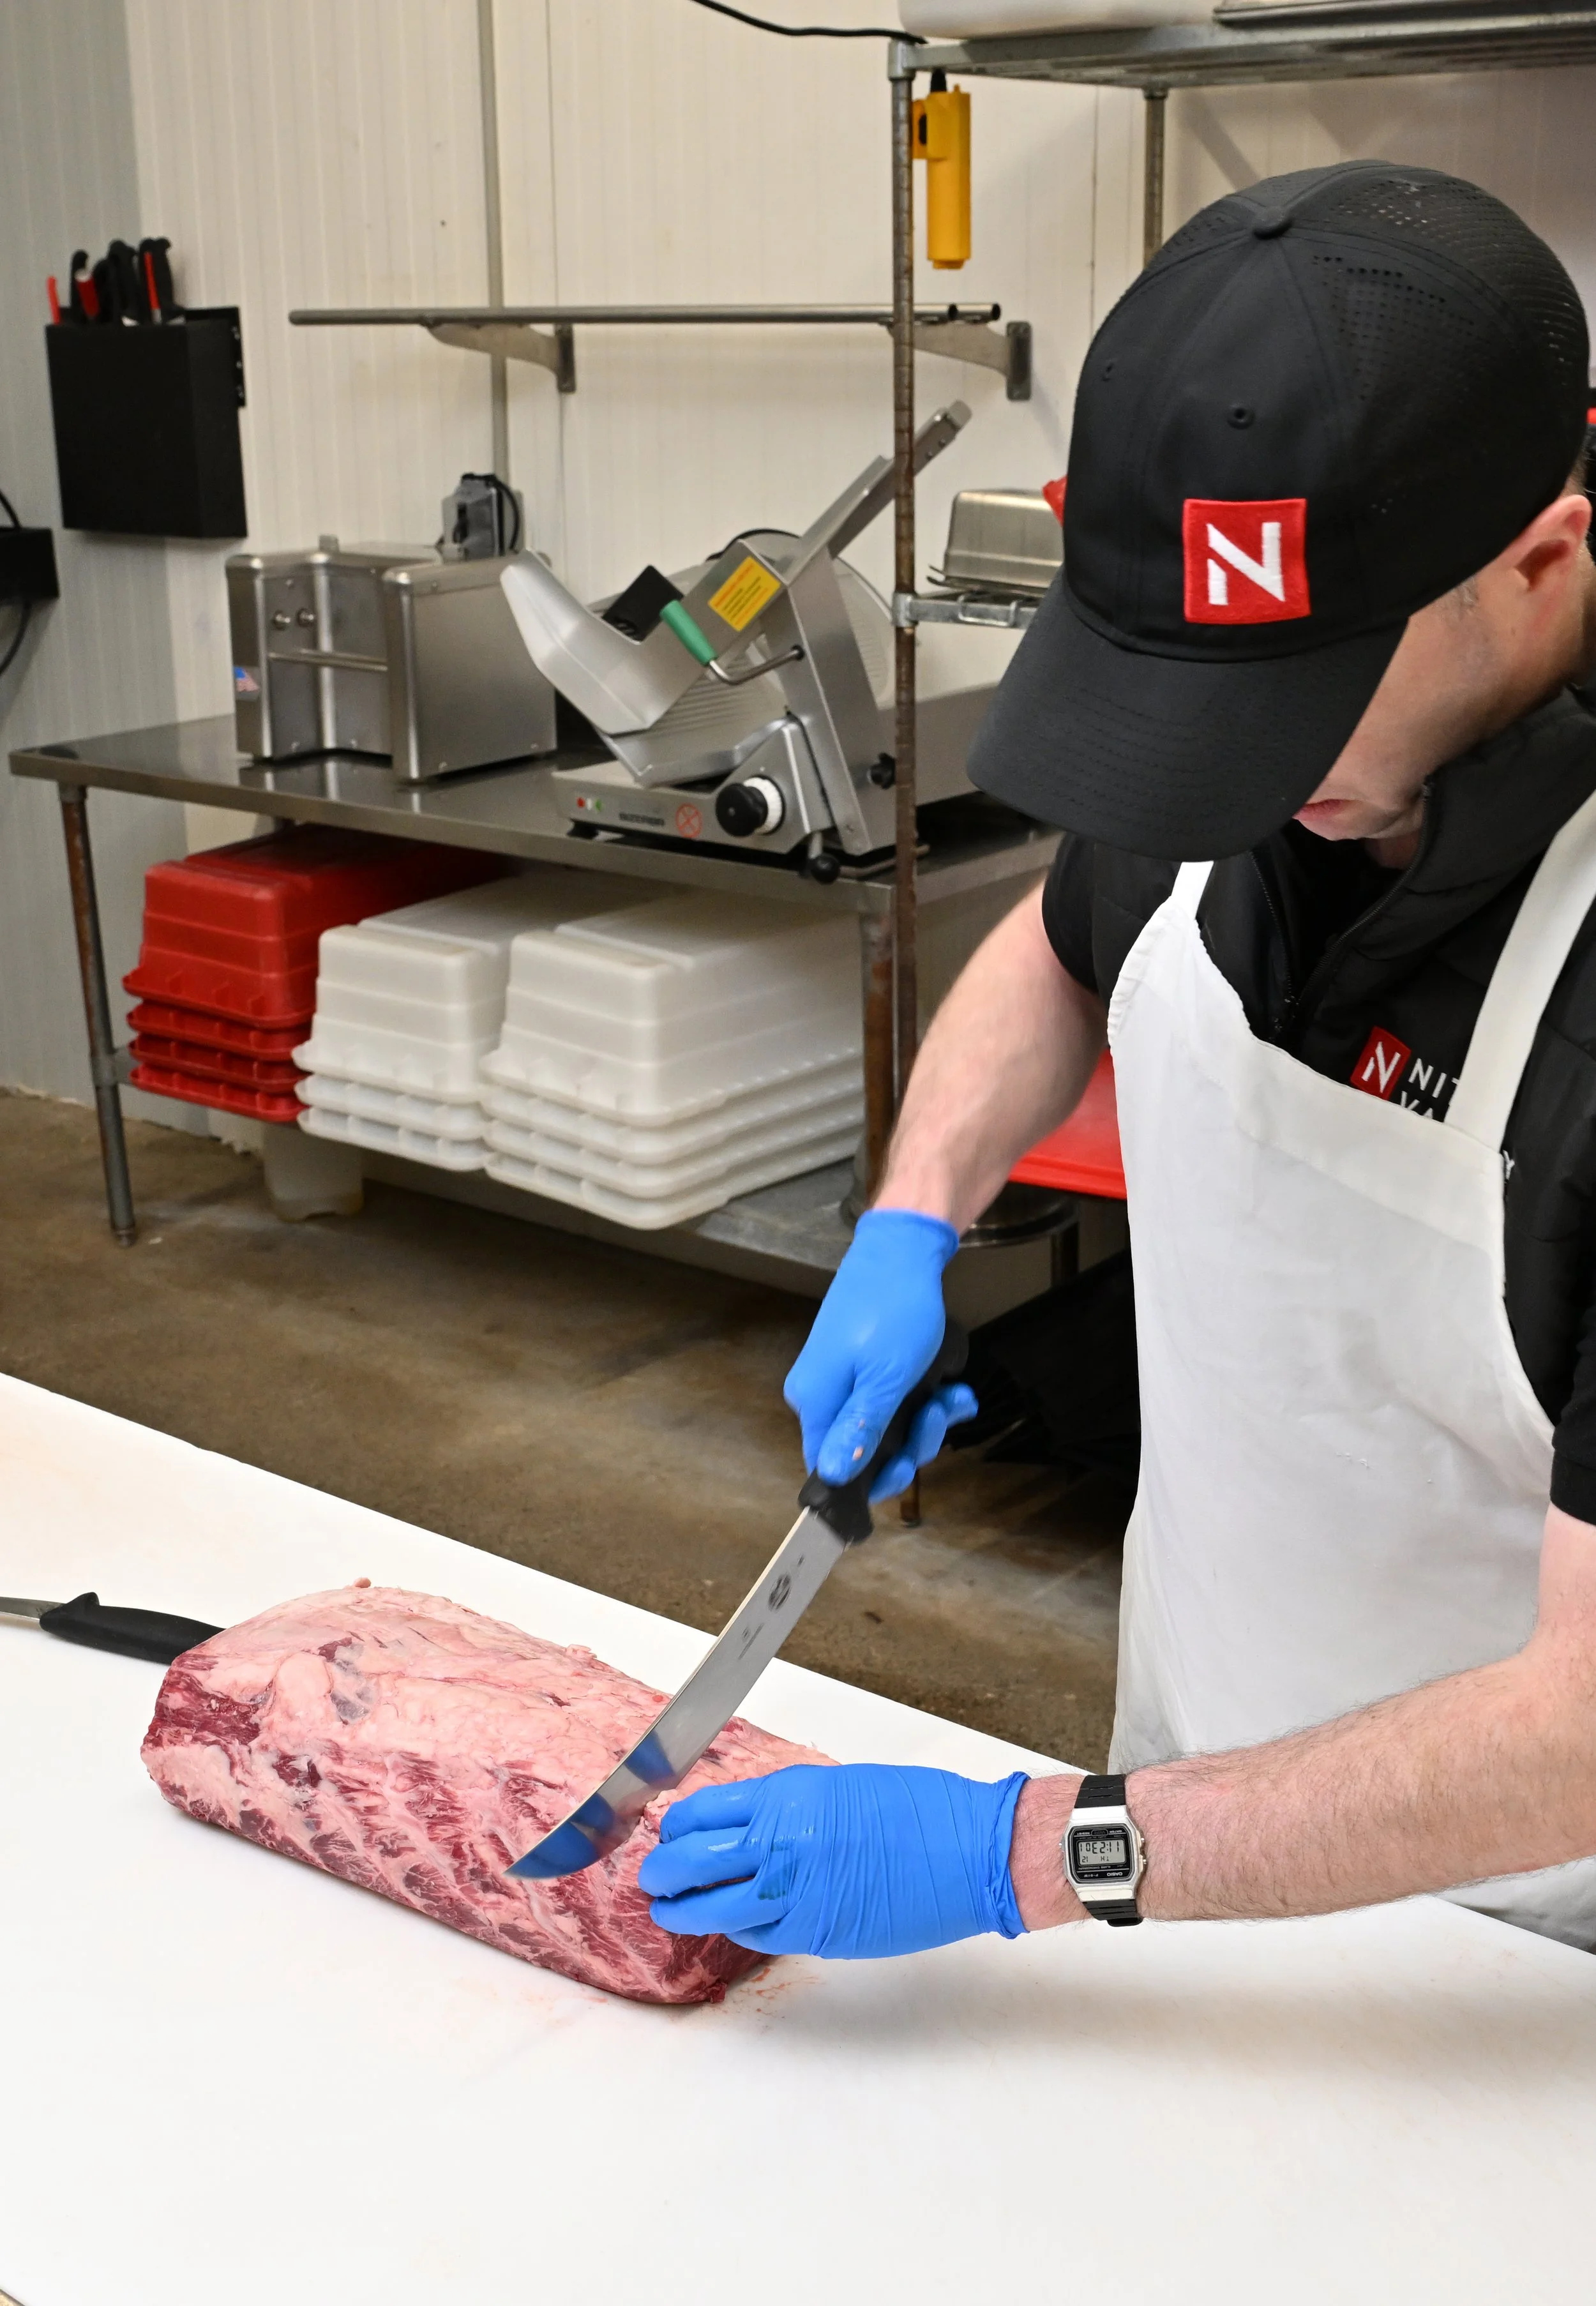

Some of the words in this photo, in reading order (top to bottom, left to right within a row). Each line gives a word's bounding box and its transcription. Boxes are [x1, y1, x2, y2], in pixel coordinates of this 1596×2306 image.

[1206, 522, 1286, 605] N
[1361, 1041, 1401, 1094] N
[1092, 1841, 1119, 1854] 11:23
